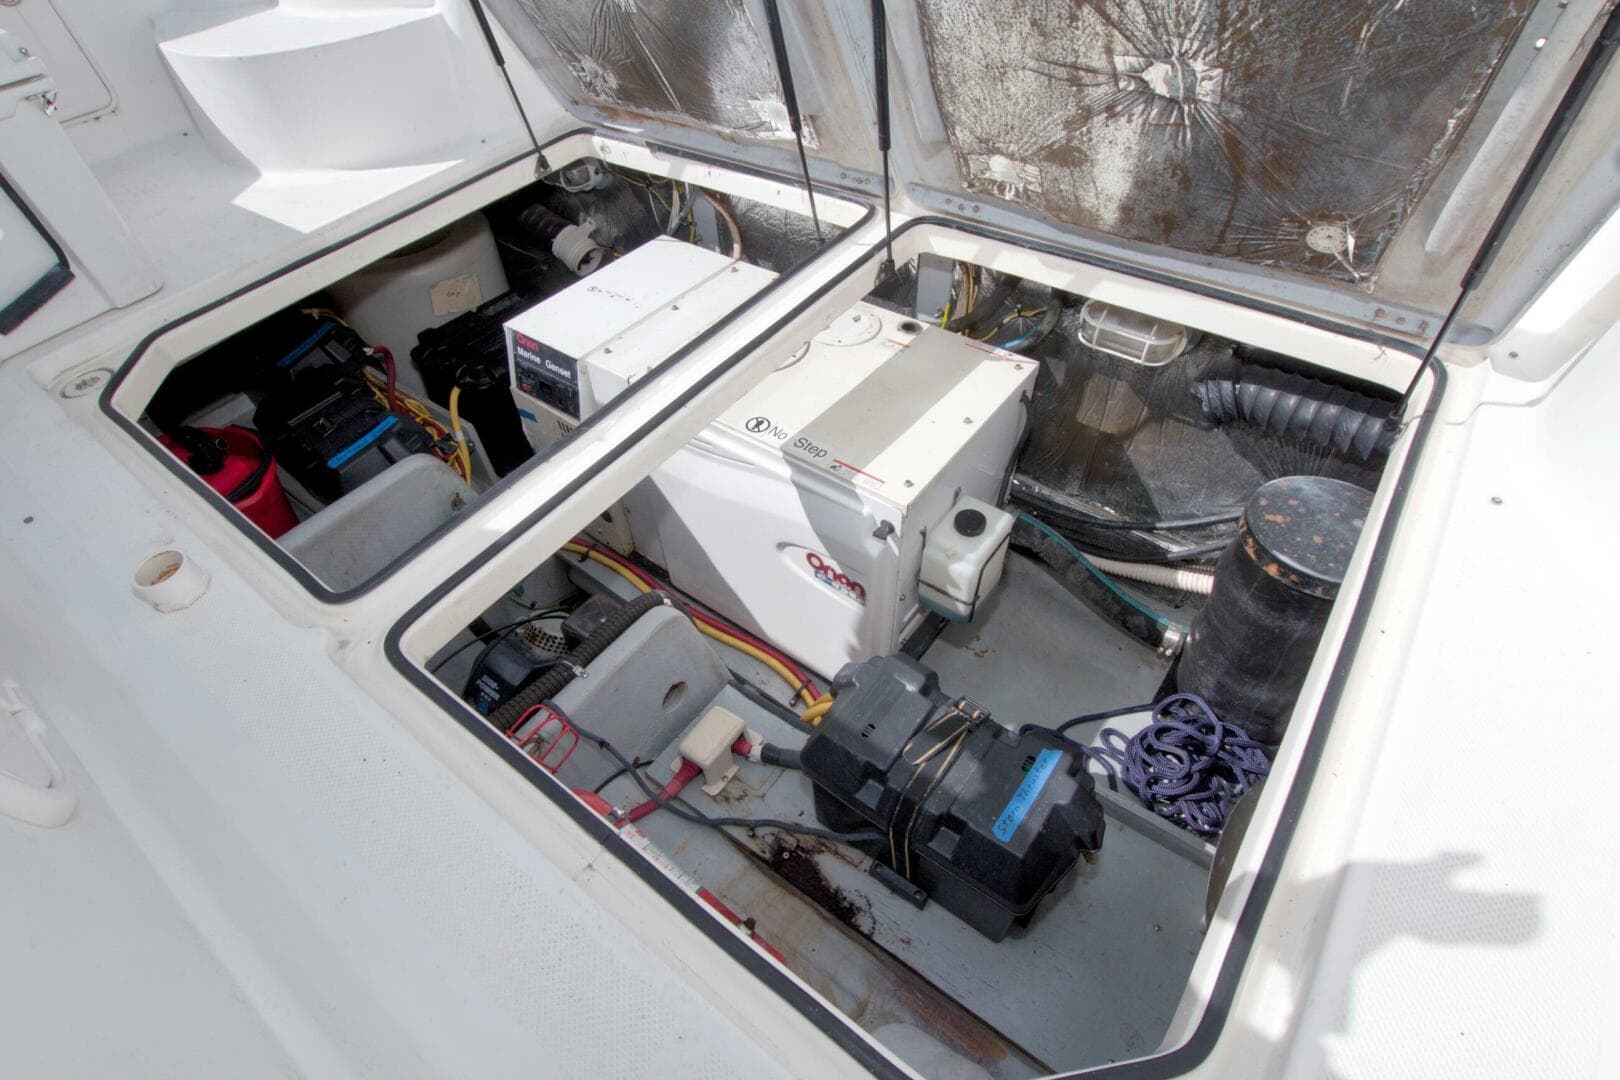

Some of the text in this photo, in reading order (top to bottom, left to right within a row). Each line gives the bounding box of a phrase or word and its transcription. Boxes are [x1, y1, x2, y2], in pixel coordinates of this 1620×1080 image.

[517, 346, 572, 379] Marine Genset
[768, 425, 828, 459] No Step
[806, 552, 866, 601] Onan
